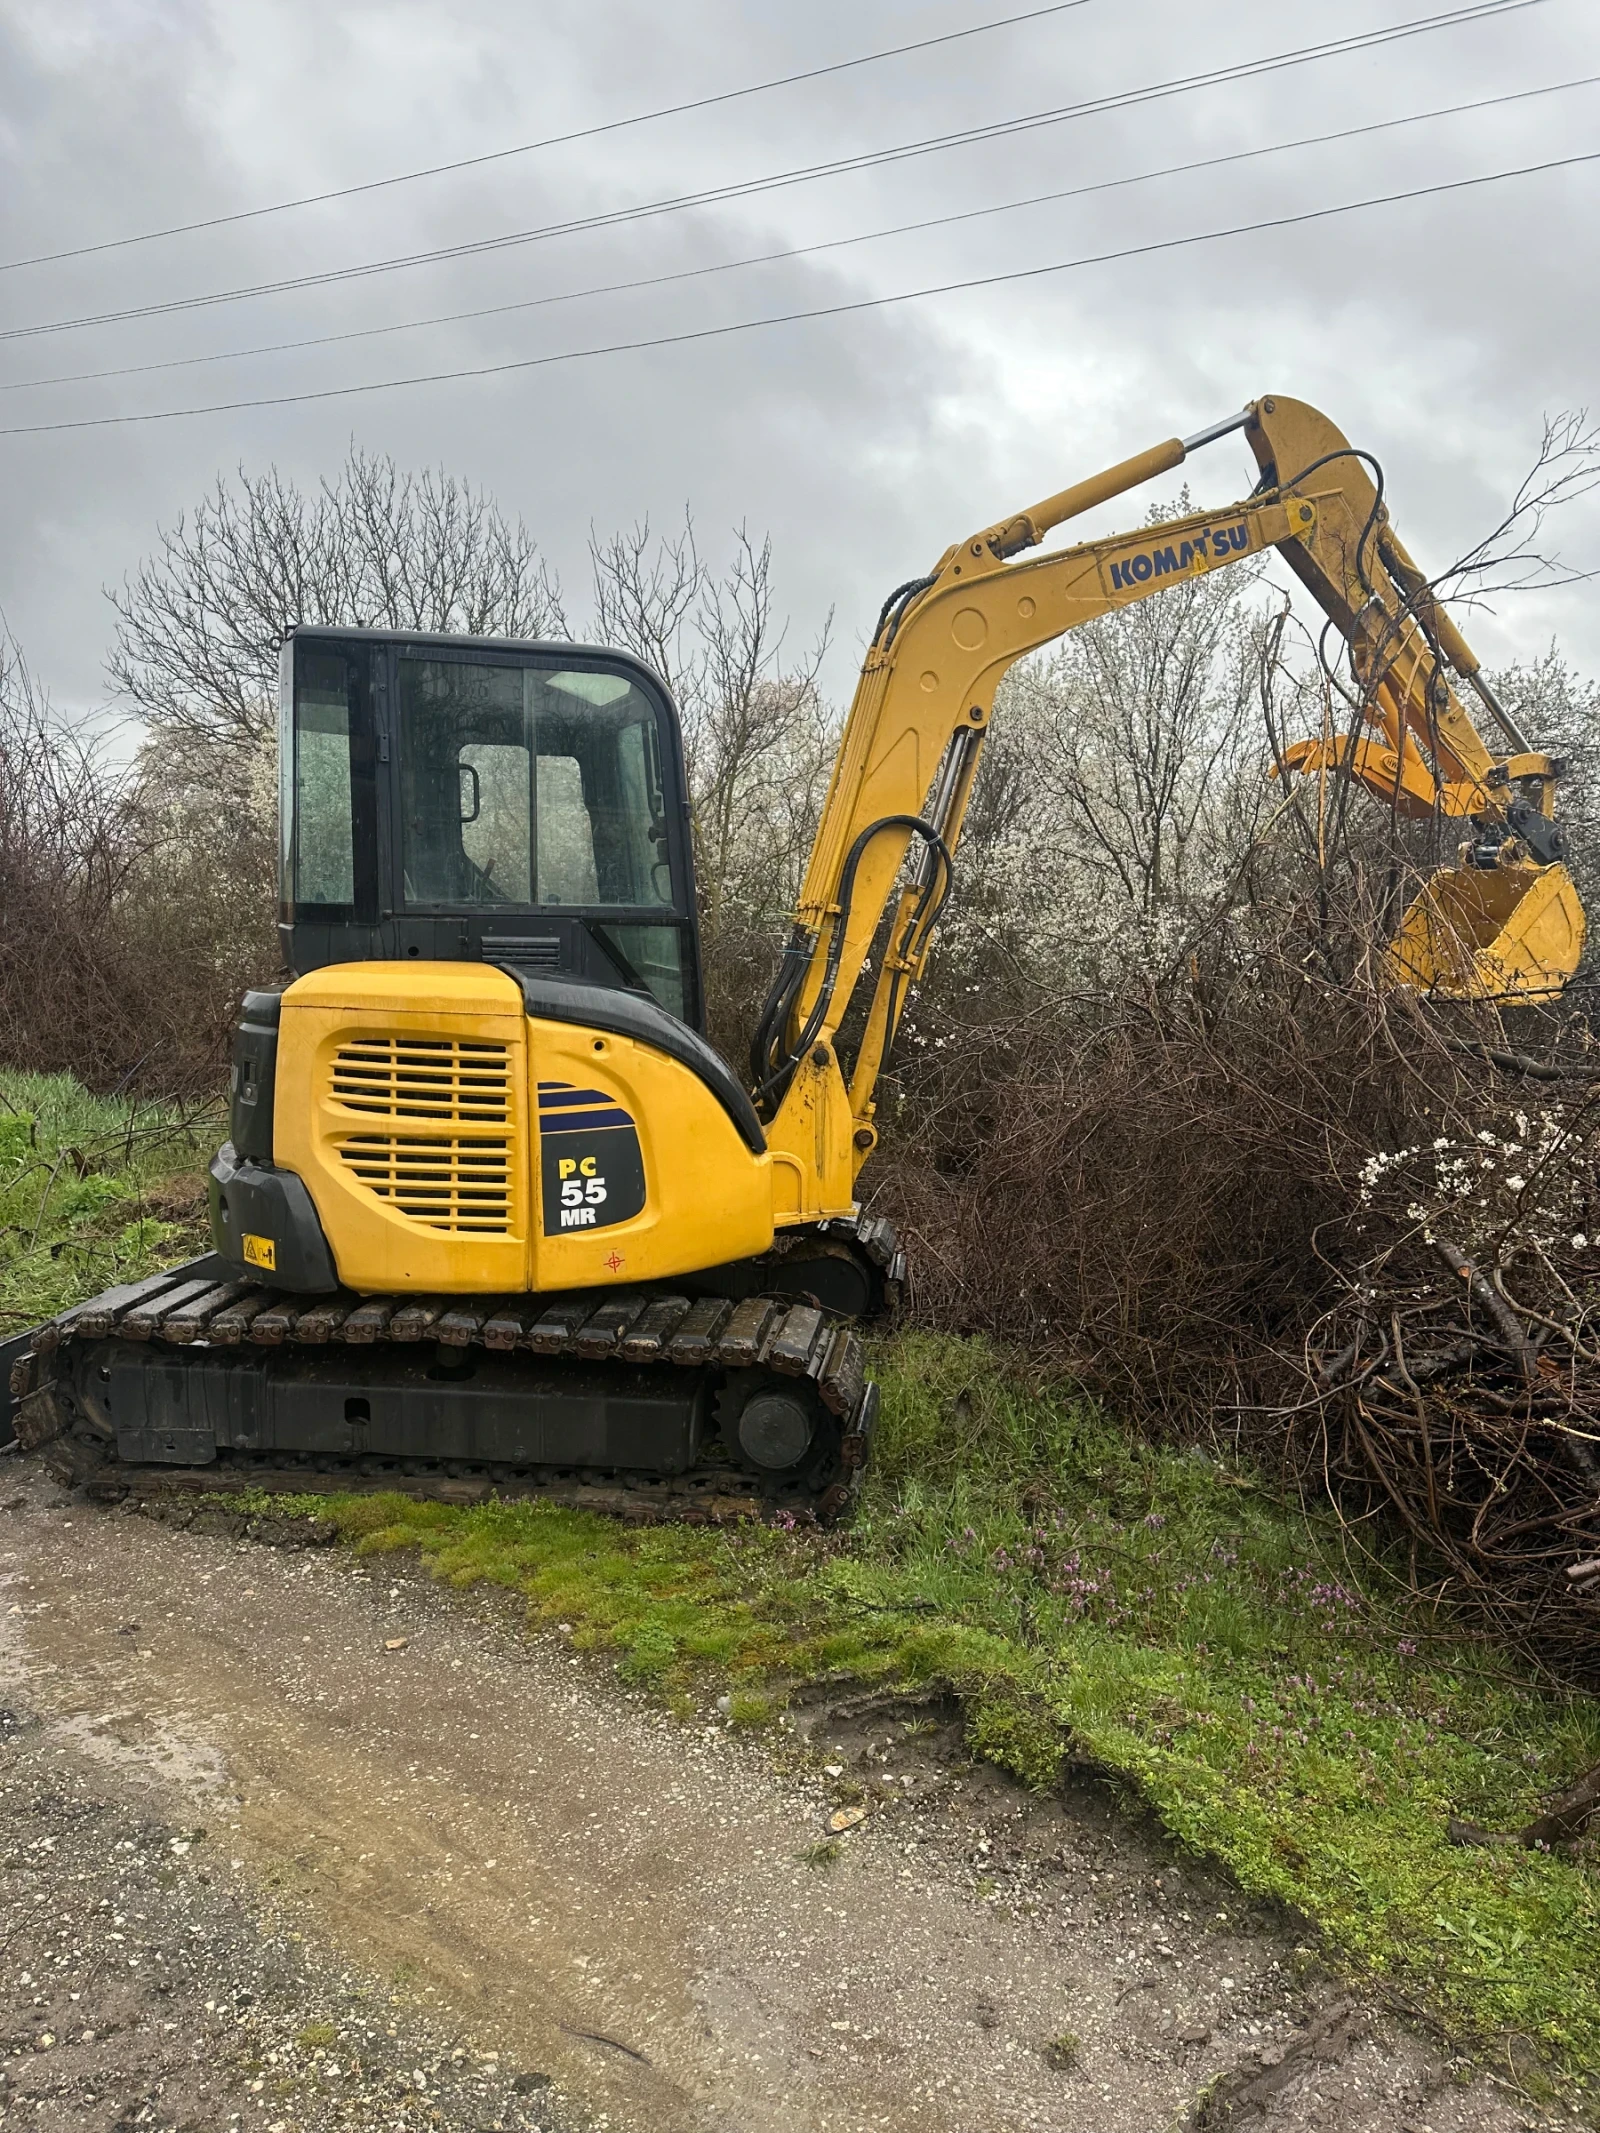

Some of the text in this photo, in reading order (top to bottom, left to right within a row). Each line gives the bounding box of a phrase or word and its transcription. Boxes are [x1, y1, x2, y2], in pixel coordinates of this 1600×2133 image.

[1110, 524, 1248, 590] KOMATSU
[559, 1156, 596, 1179] PC
[560, 1177, 607, 1207] 55
[561, 1207, 596, 1227] MR
